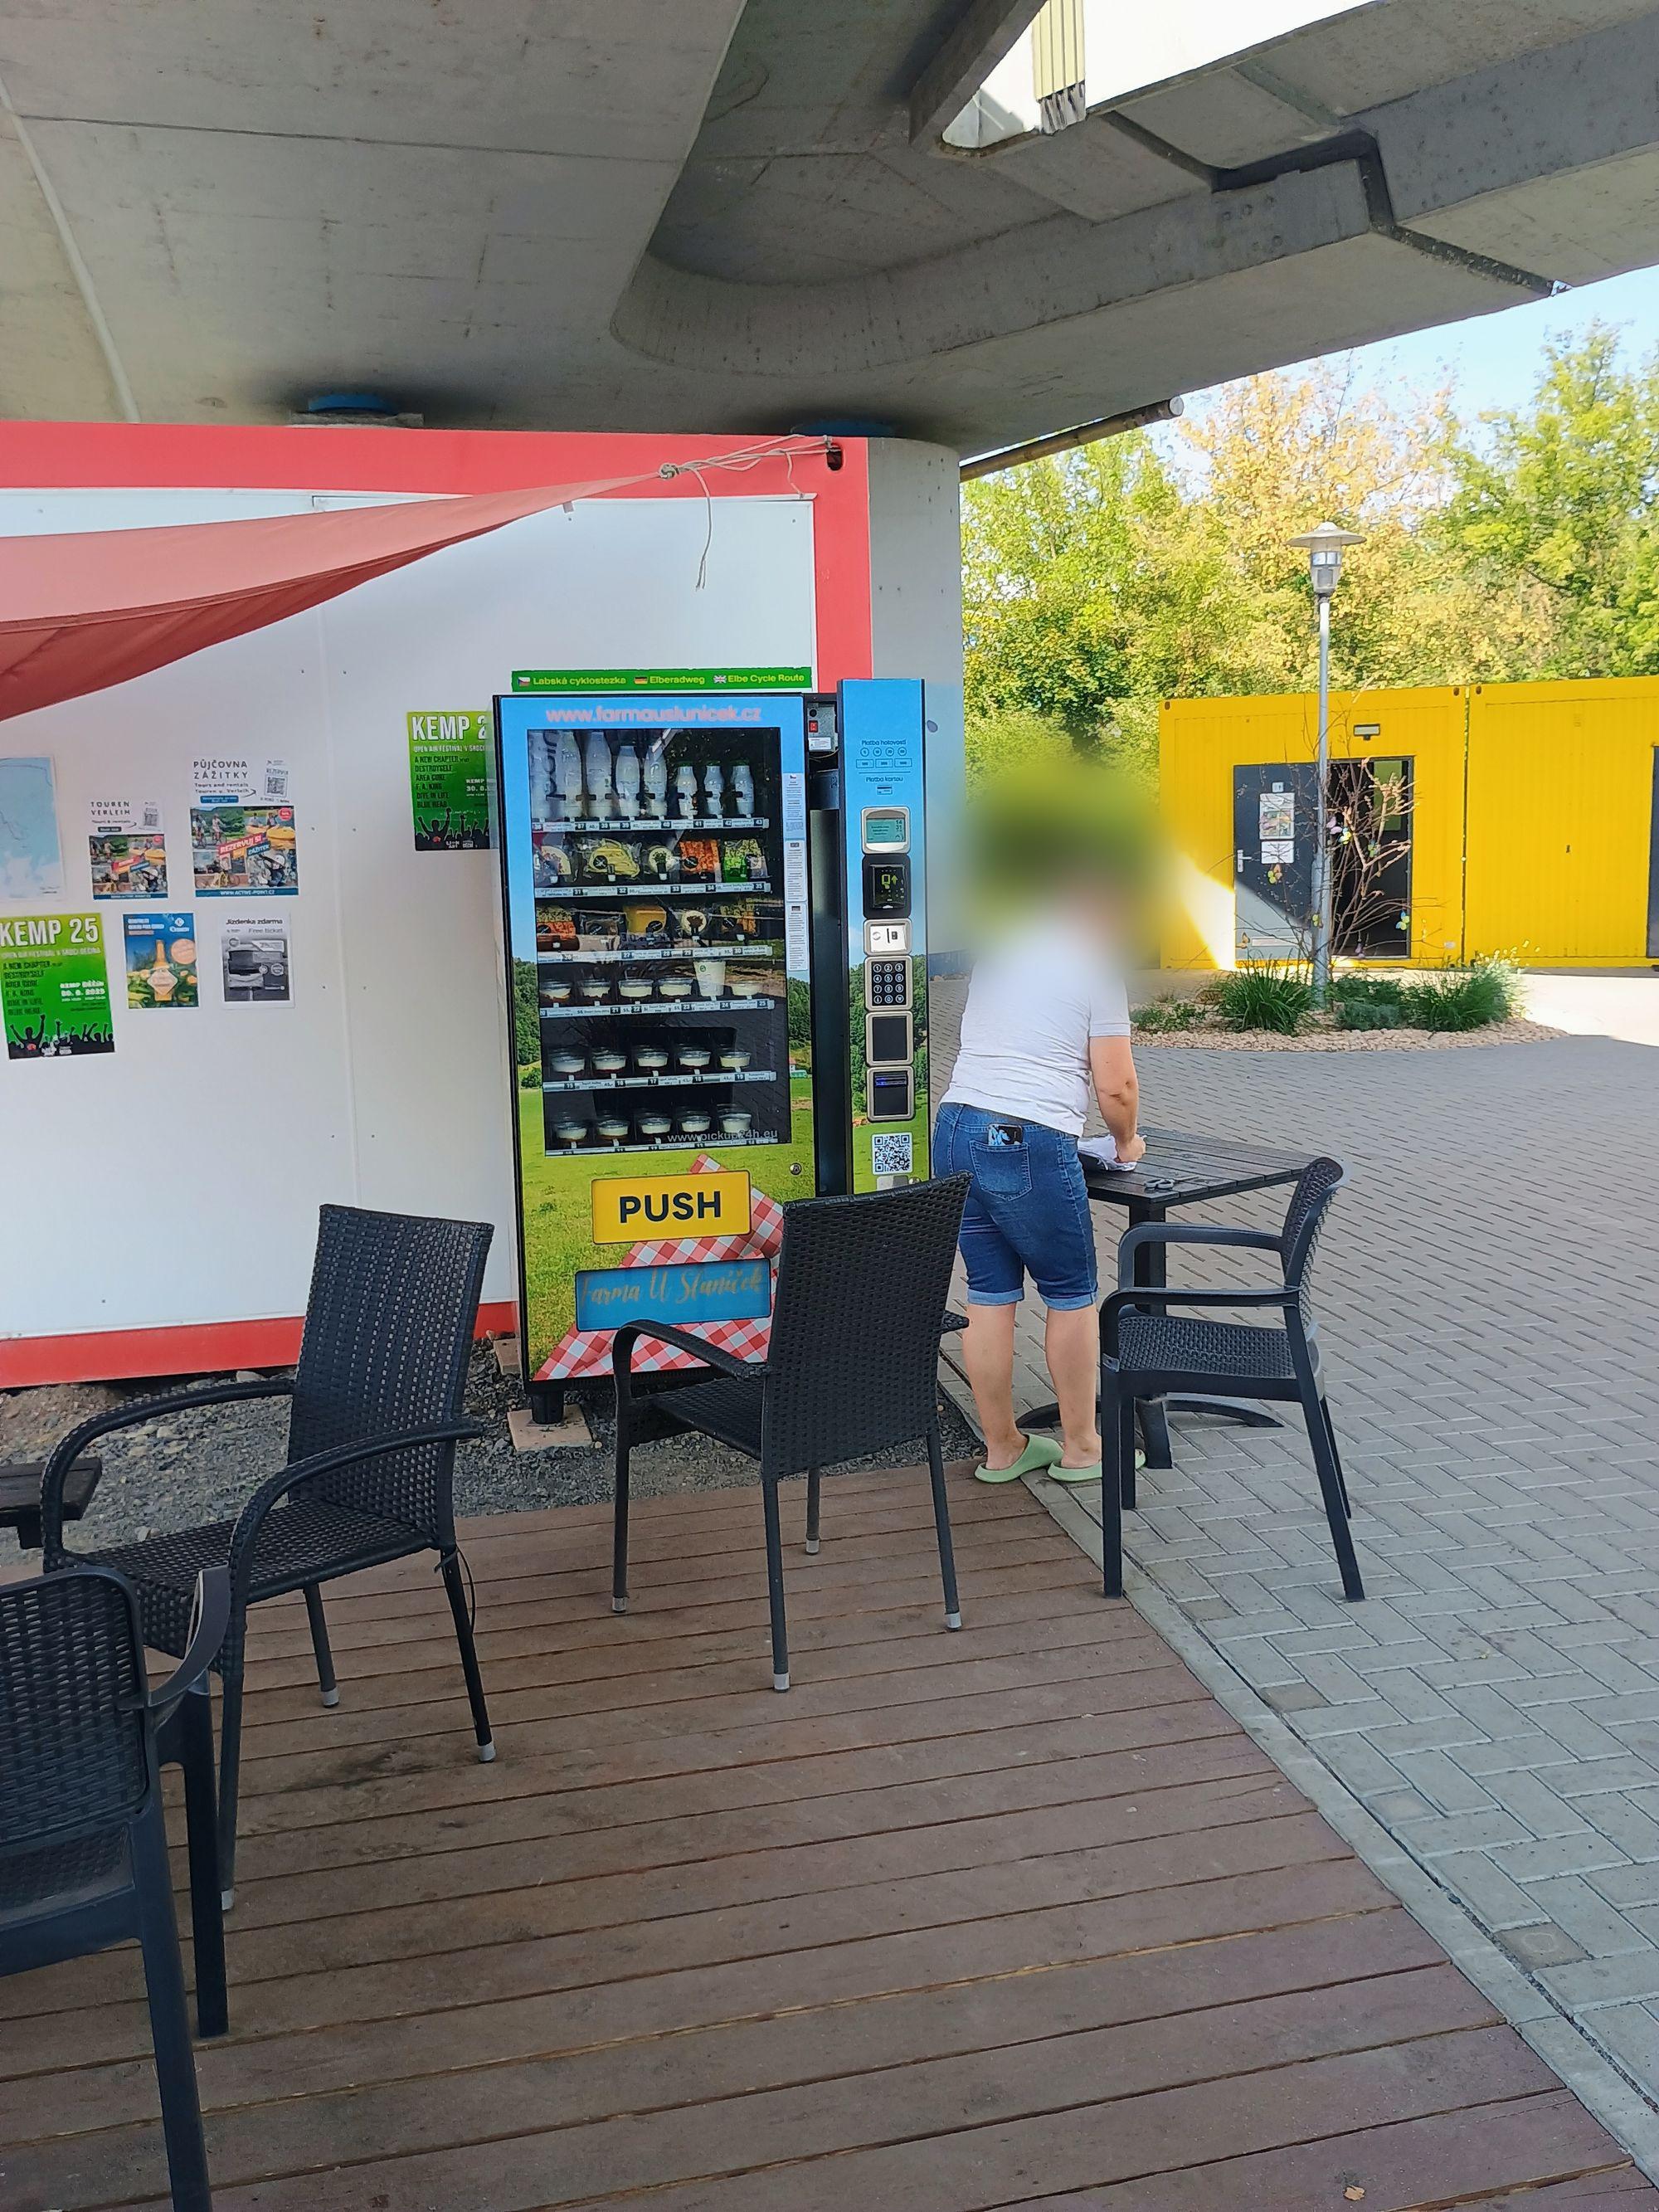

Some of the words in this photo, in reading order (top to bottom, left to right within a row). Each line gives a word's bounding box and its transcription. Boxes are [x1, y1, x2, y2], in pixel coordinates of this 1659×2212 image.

[569, 676, 627, 686] cyklostezka
[649, 675, 705, 685] Elberadweg
[727, 675, 748, 683] Elbe
[750, 675, 776, 684] Cycle
[778, 674, 805, 682] Route
[411, 715, 471, 741] KEMP
[193, 758, 248, 770] PŮJČOVNA
[193, 770, 248, 779] ZÁŽITKY
[0, 919, 61, 947] KEMP
[69, 918, 99, 944] 25
[667, 1128, 779, 1143] www.pickup24h.eu
[619, 1190, 722, 1224] PUSH
[580, 1274, 640, 1309] Farma
[649, 1266, 668, 1303] U
